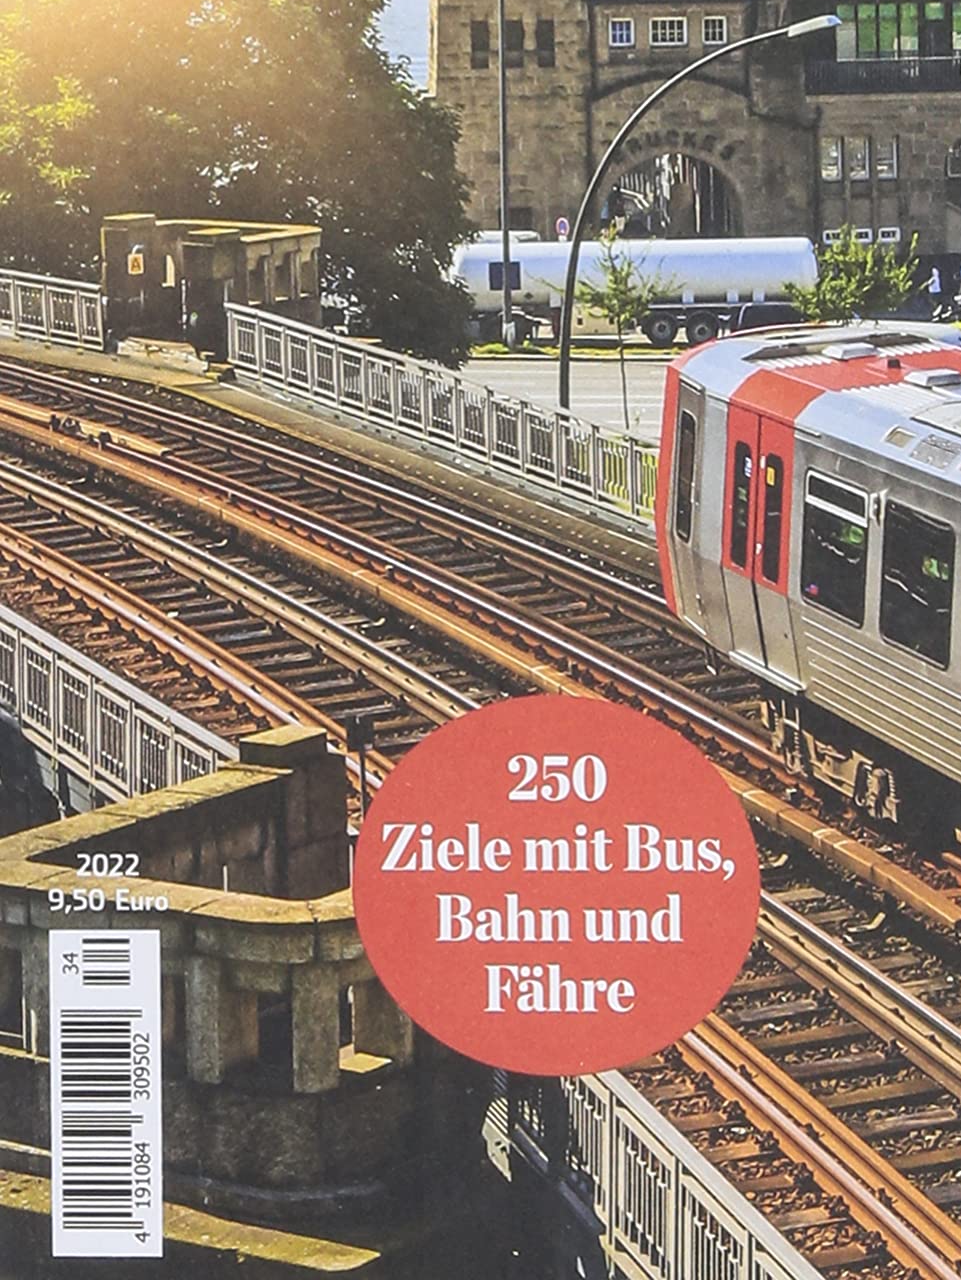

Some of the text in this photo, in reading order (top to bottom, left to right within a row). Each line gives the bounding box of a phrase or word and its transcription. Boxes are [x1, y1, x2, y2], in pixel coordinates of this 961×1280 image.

[507, 754, 607, 802] 250
[75, 853, 140, 878] 2022
[381, 823, 735, 881] Ziele mit Bus,
[48, 887, 171, 914] 9,50 Euro
[435, 893, 684, 942] Bahn und
[62, 952, 80, 974] 34
[483, 964, 635, 1013] Fähre
[133, 1032, 151, 1100] 309502
[134, 1142, 151, 1208] 191084
